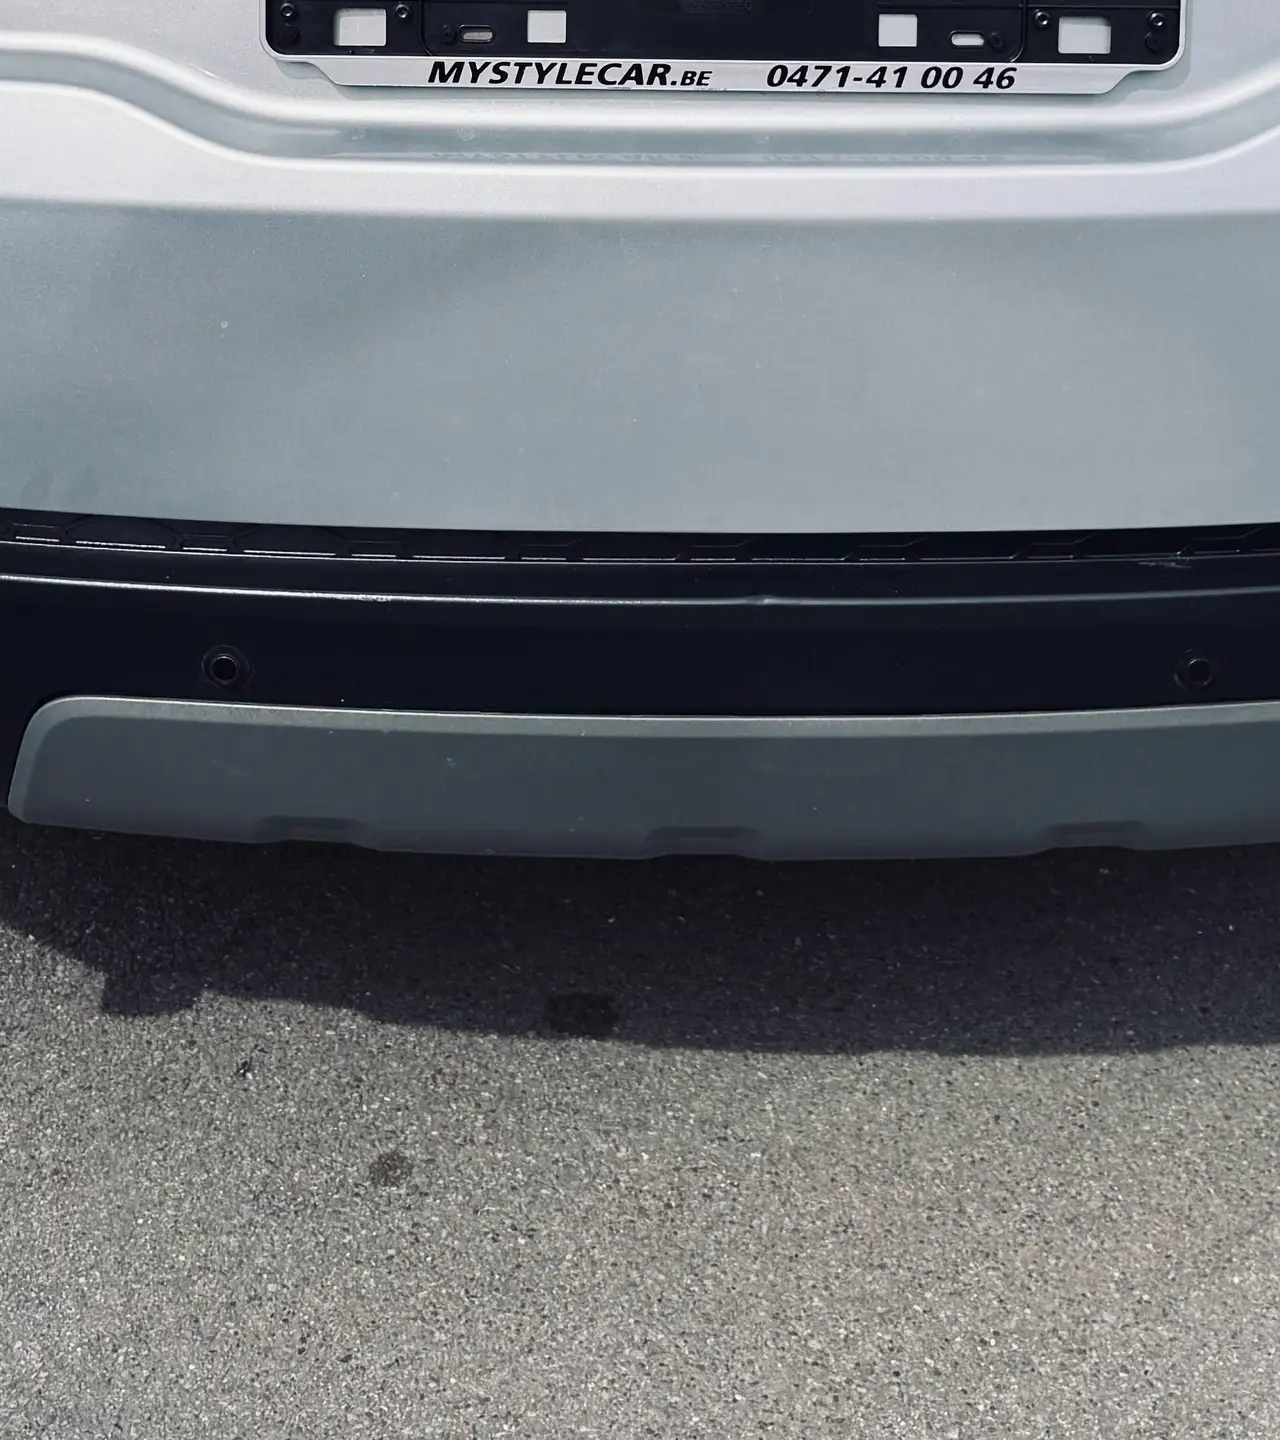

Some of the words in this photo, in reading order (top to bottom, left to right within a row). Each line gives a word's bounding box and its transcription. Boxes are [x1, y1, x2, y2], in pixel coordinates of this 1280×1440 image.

[427, 61, 713, 87] MYSTYLECAR.BE
[766, 64, 909, 89] 0471-41
[920, 66, 965, 89] 00
[972, 67, 1018, 90] 46
